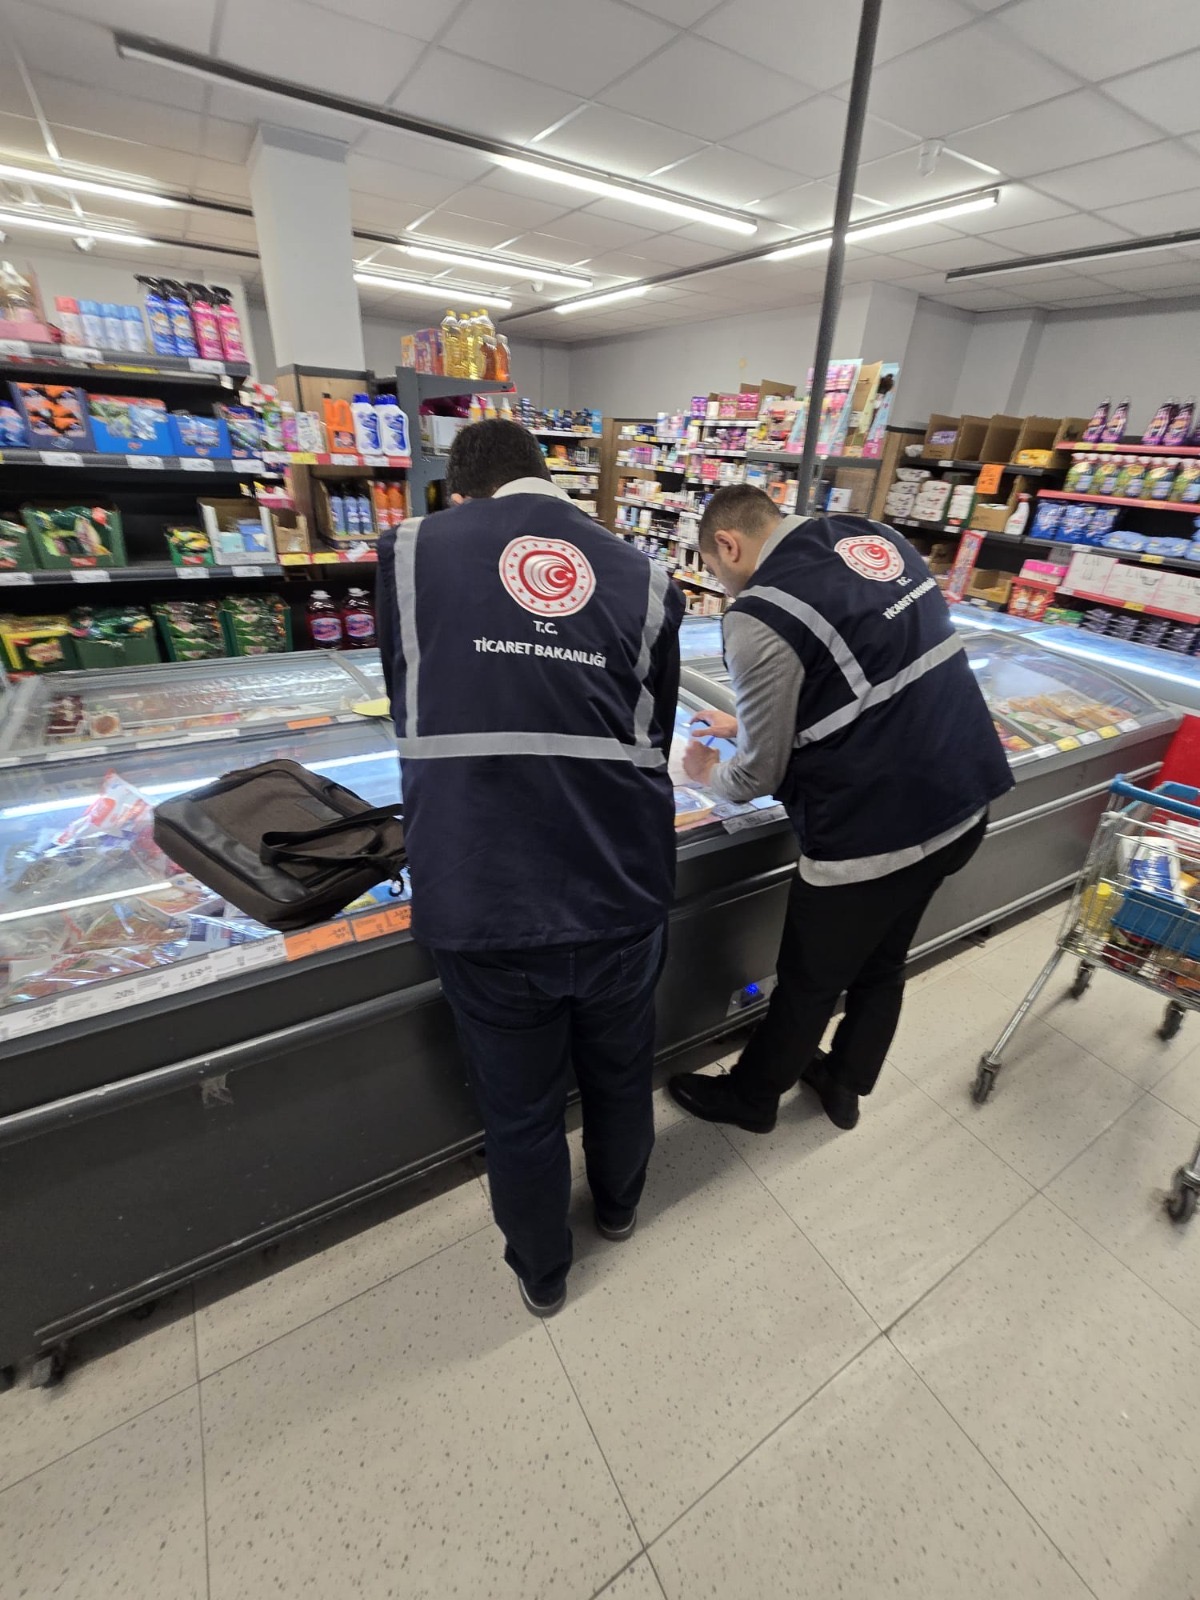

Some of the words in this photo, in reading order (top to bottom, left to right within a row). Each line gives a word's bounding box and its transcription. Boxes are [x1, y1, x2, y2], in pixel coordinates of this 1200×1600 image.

[533, 620, 558, 635] T.C.
[473, 636, 534, 655] TİCARET
[534, 644, 607, 668] BAKANLIĞI
